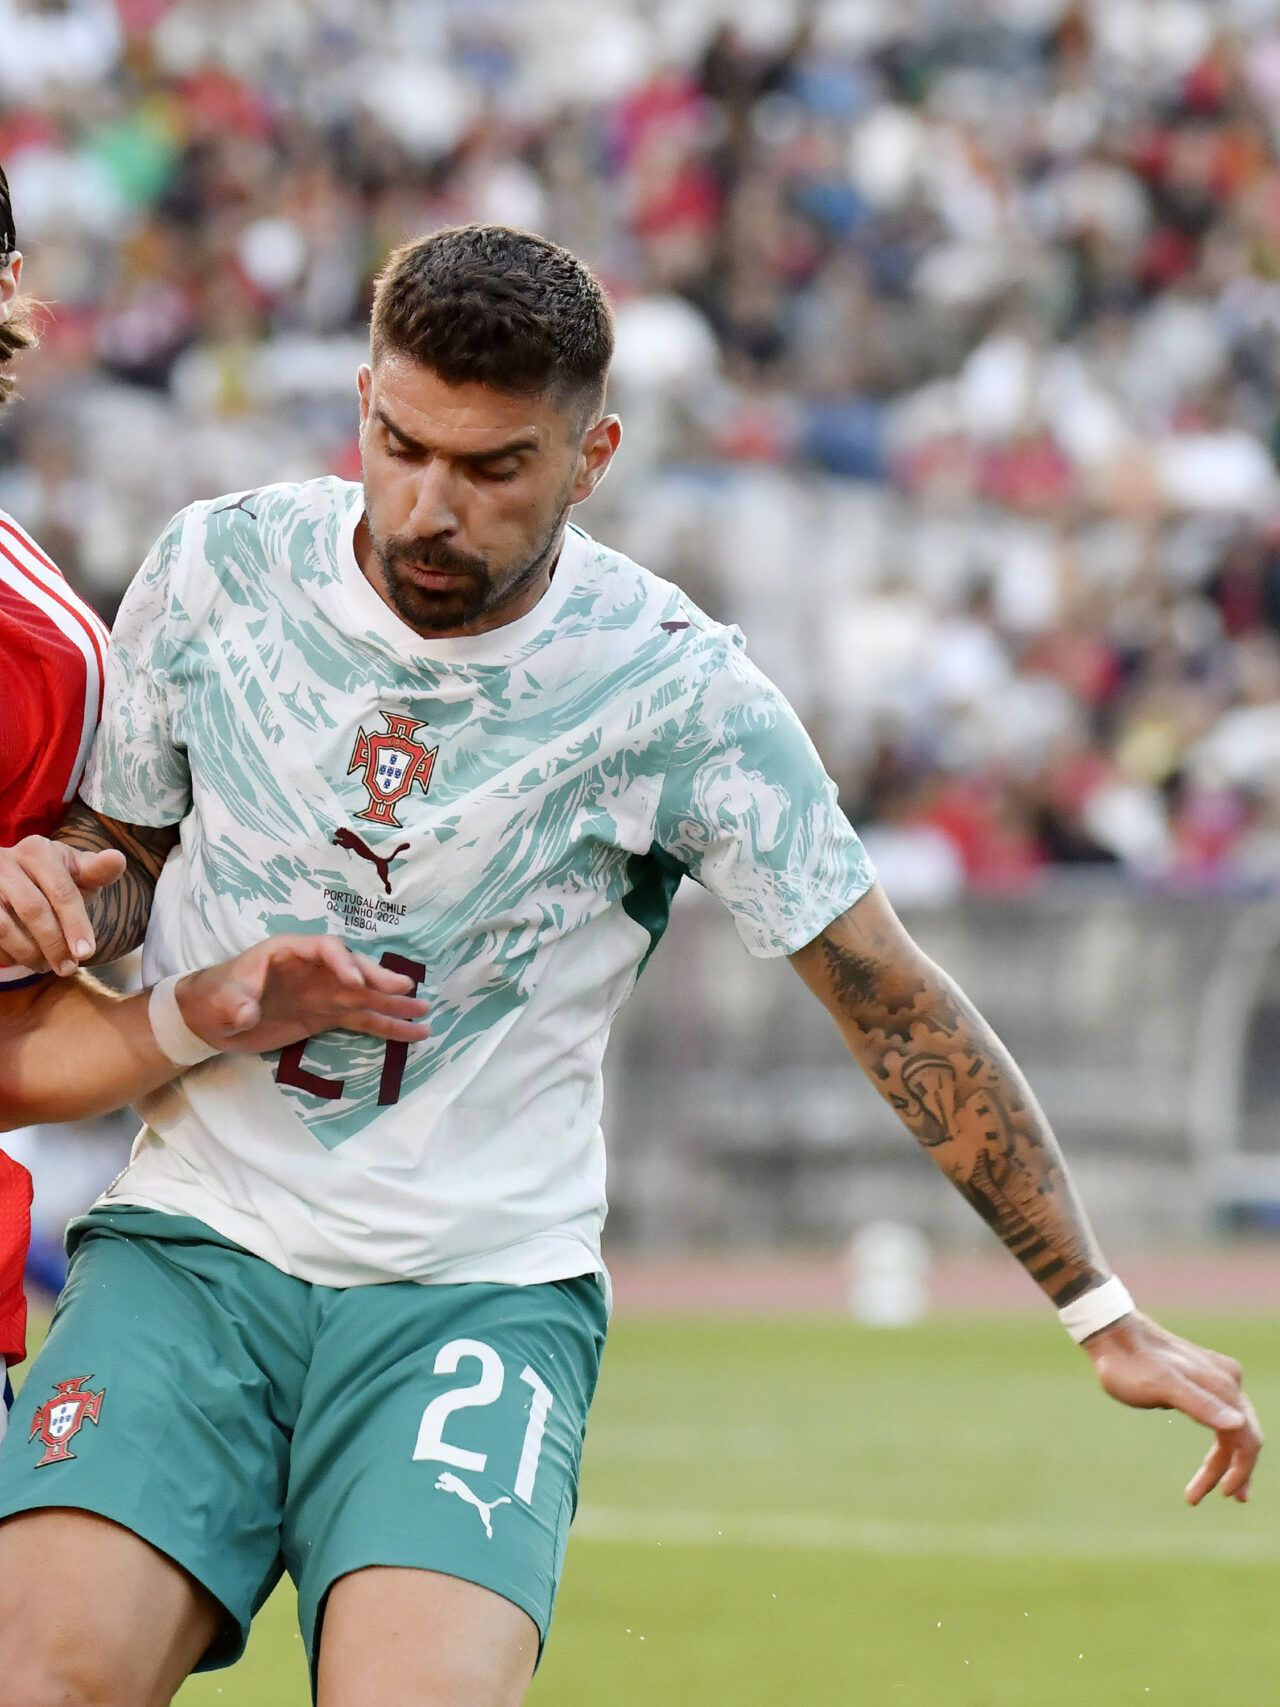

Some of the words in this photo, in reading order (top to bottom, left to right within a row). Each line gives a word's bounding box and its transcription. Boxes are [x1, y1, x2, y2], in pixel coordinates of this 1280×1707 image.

[323, 889, 407, 916] PORTUGAL/CHILE
[342, 904, 373, 918] JUNHO
[345, 916, 377, 932] LISBOA
[412, 1338, 554, 1505] 21
